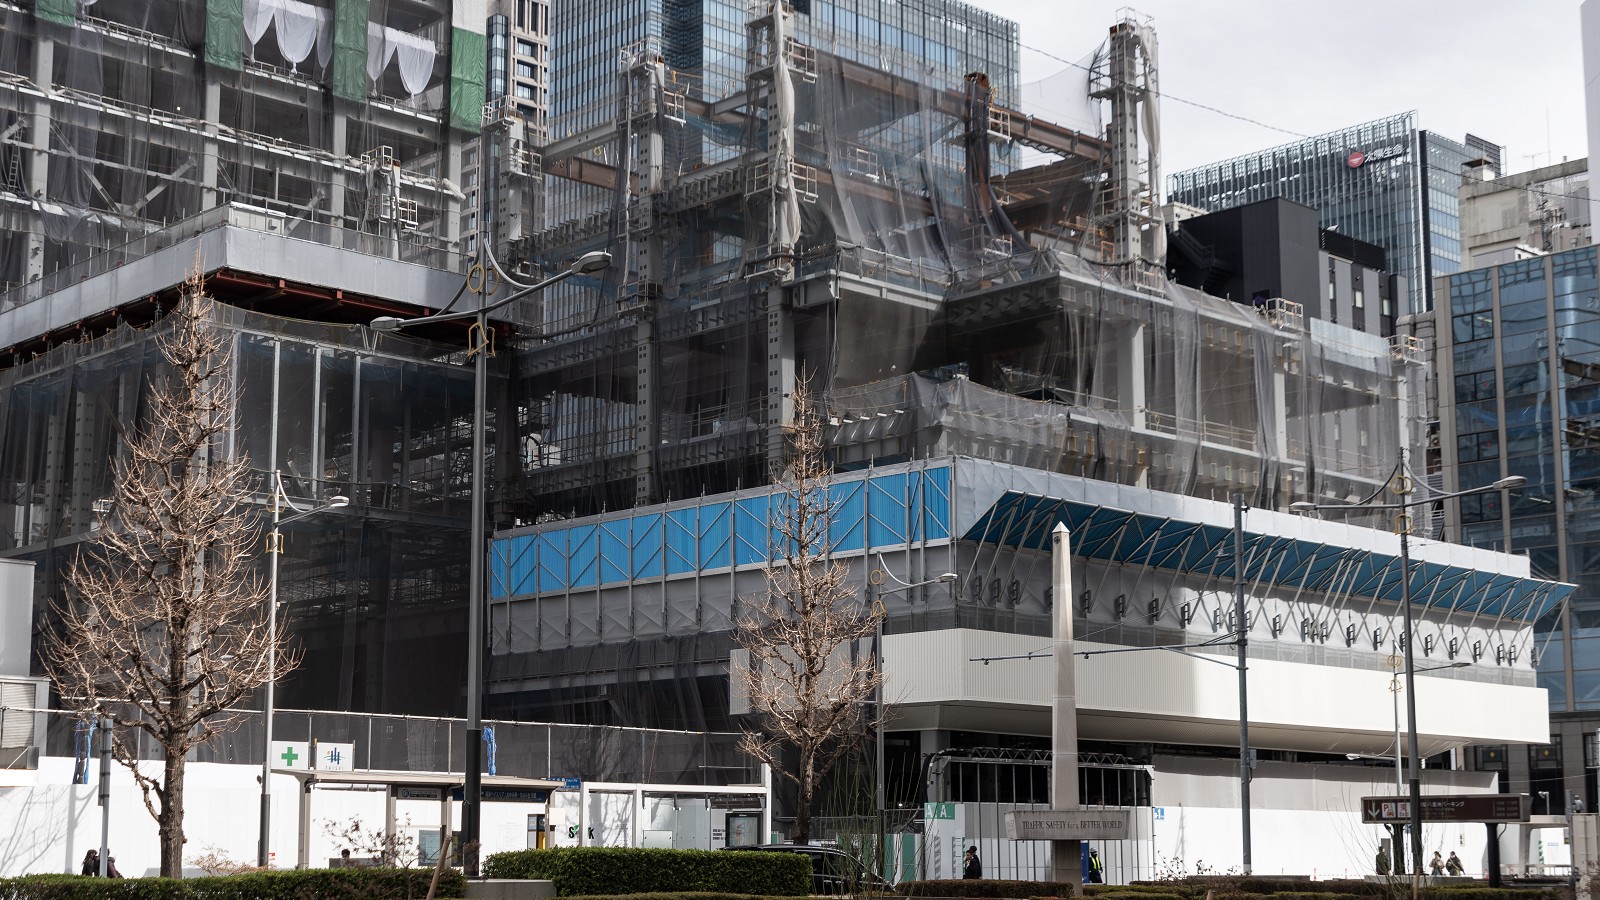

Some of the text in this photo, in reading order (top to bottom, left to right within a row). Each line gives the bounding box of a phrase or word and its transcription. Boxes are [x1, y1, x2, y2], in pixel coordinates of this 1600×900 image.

[940, 804, 947, 818] A
[1023, 820, 1045, 829] TRAFFIC
[1046, 820, 1067, 829] SAFETY
[1080, 820, 1101, 829] BETTER
[1102, 820, 1123, 829] WORLD
